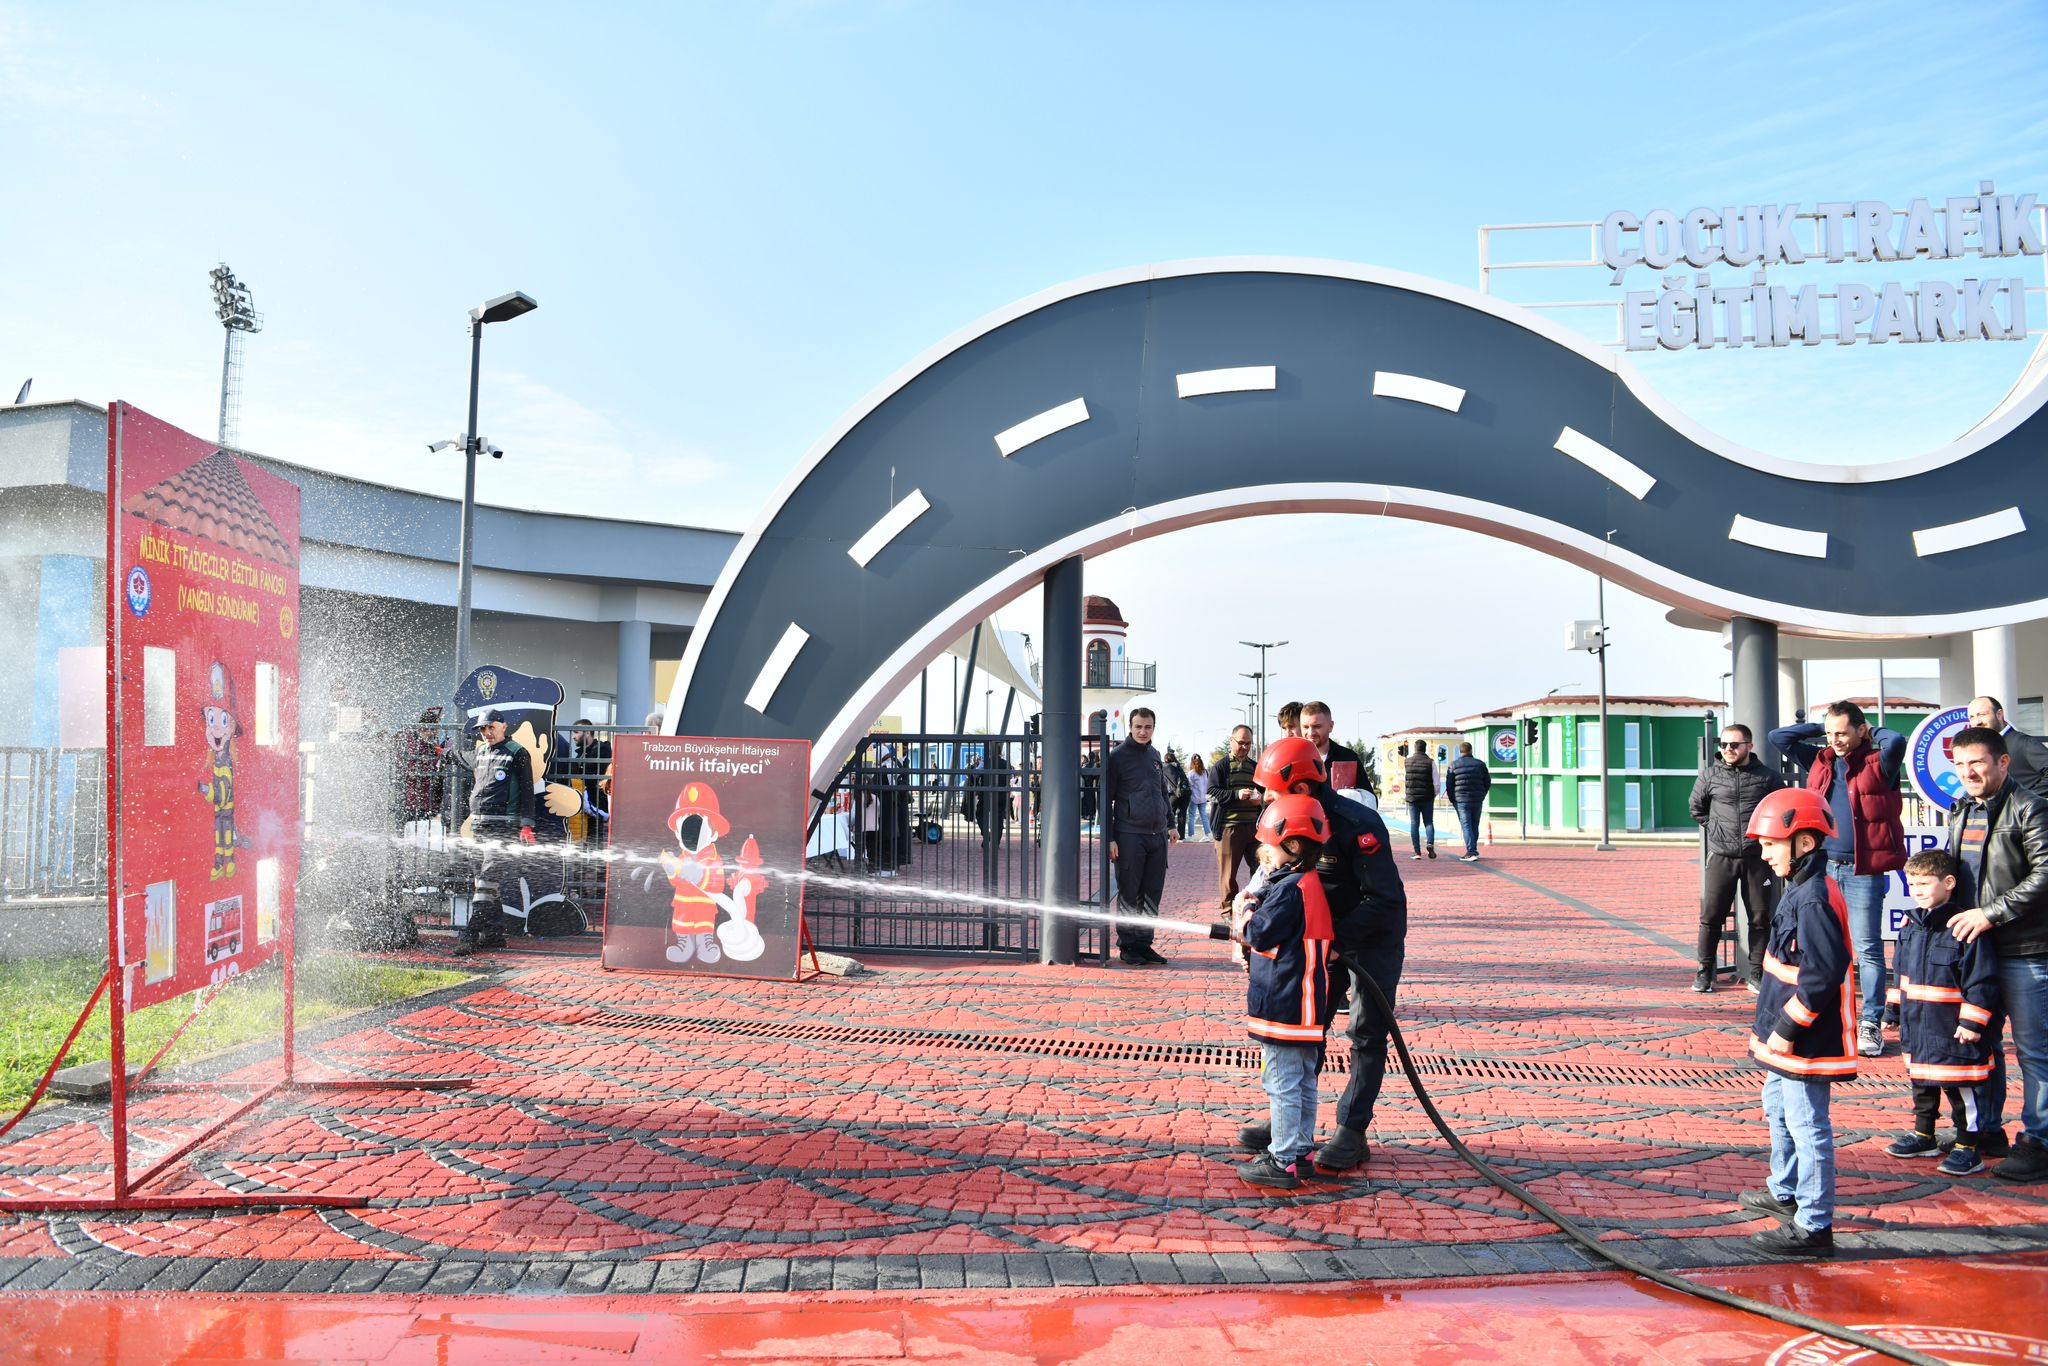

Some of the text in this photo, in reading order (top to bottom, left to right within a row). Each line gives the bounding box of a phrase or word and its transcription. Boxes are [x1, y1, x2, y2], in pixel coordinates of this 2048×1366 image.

[1601, 180, 2045, 286] ÇOCUK TRAFİK
[1624, 271, 2027, 352] EĞİTİM PARKI
[140, 531, 170, 565] MİNİK
[173, 539, 229, 581] İTFAİYECİLER
[231, 557, 259, 589] EĞİTİM
[178, 583, 215, 614] (YANGIN
[216, 590, 260, 629] SÖNDÜRME)
[642, 741, 780, 758] Trabzon Büyükşehir İtfaiyesi
[1917, 711, 1969, 773] TRABZON BÜYÜK
